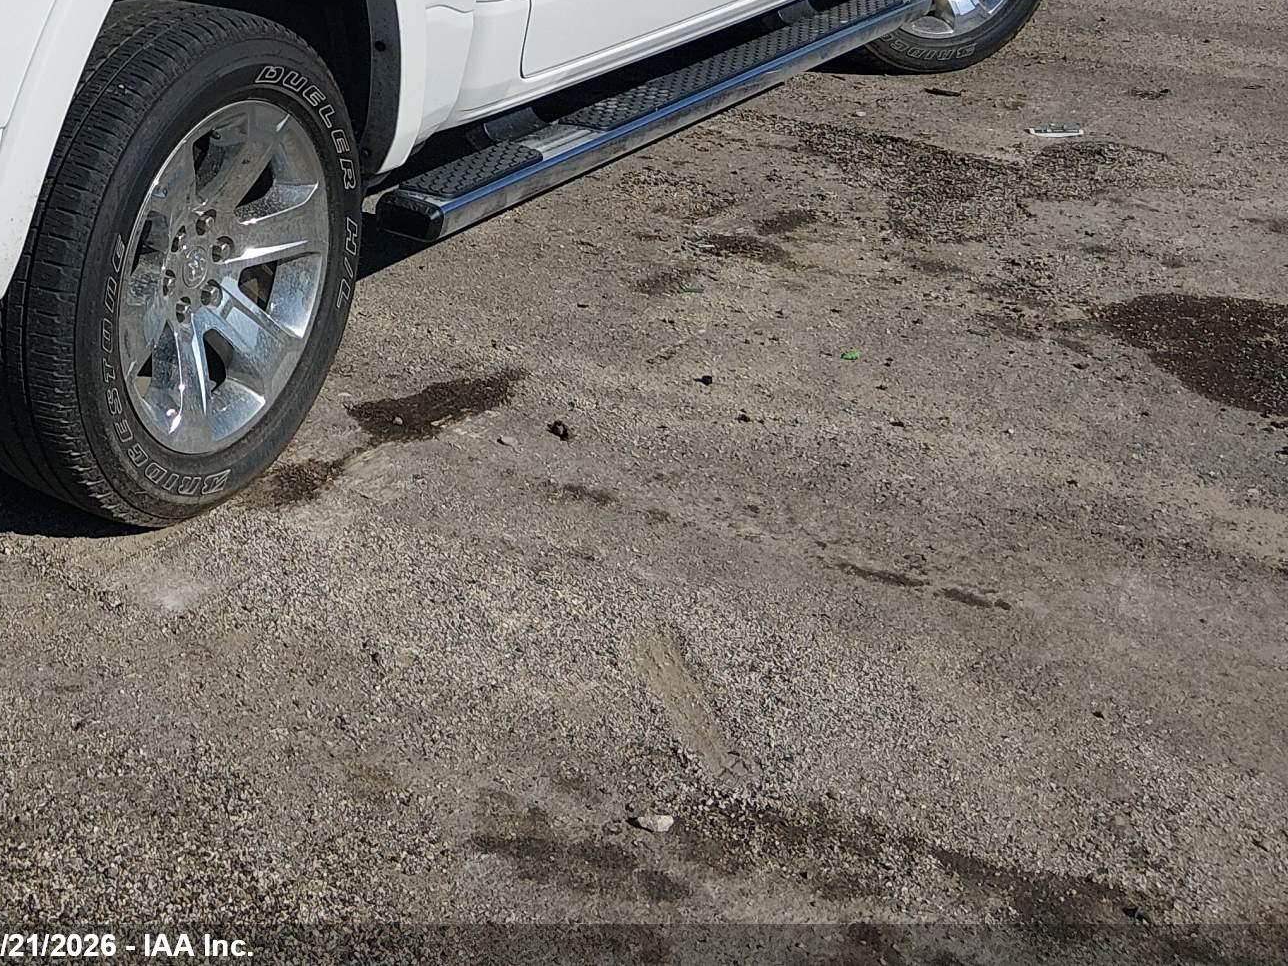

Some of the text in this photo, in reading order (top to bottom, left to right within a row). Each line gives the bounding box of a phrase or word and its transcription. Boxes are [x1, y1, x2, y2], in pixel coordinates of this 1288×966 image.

[255, 65, 358, 309] DUELER H/L
[101, 233, 232, 496] BRIDGESTONE
